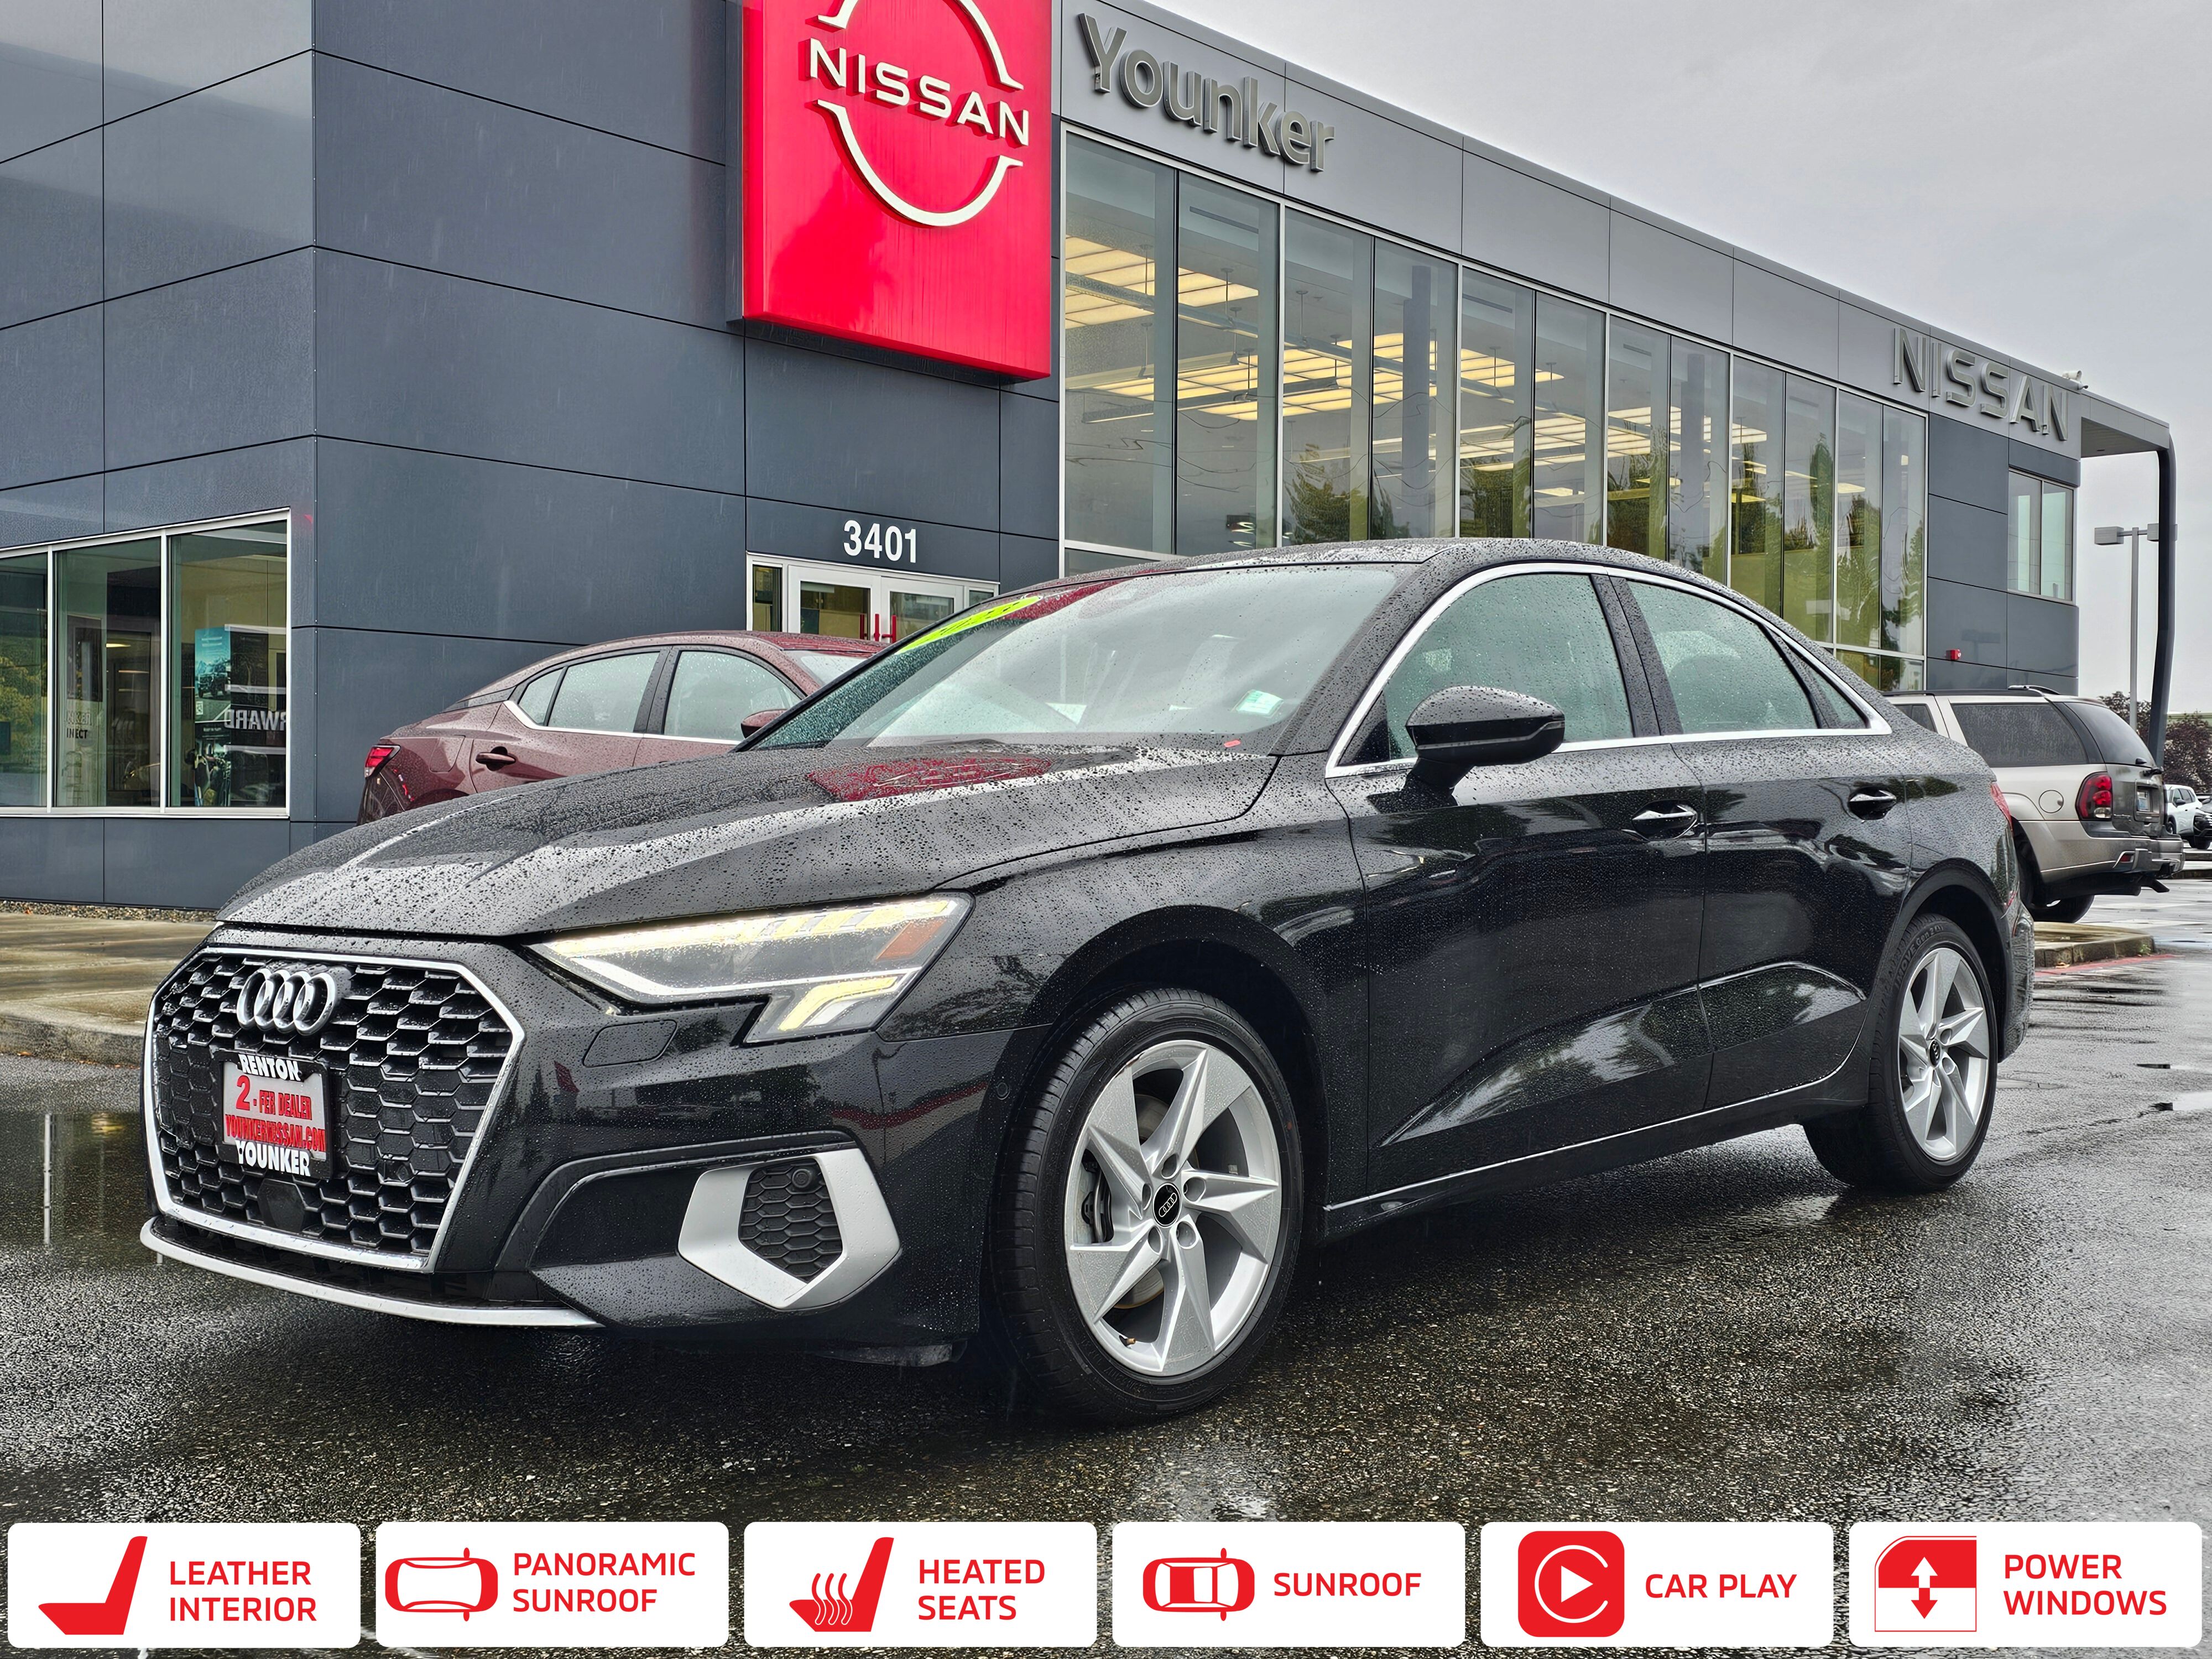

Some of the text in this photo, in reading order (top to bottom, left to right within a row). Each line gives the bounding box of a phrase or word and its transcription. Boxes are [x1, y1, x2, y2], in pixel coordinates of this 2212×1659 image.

[810, 38, 1029, 147] NISSAN
[1078, 13, 1334, 172] Younker
[1893, 327, 2069, 441] NISSAN
[843, 519, 917, 564] 3401
[238, 1053, 301, 1082] RENTON
[278, 1092, 312, 1121] DEALER
[234, 1140, 311, 1177] YOUNKER
